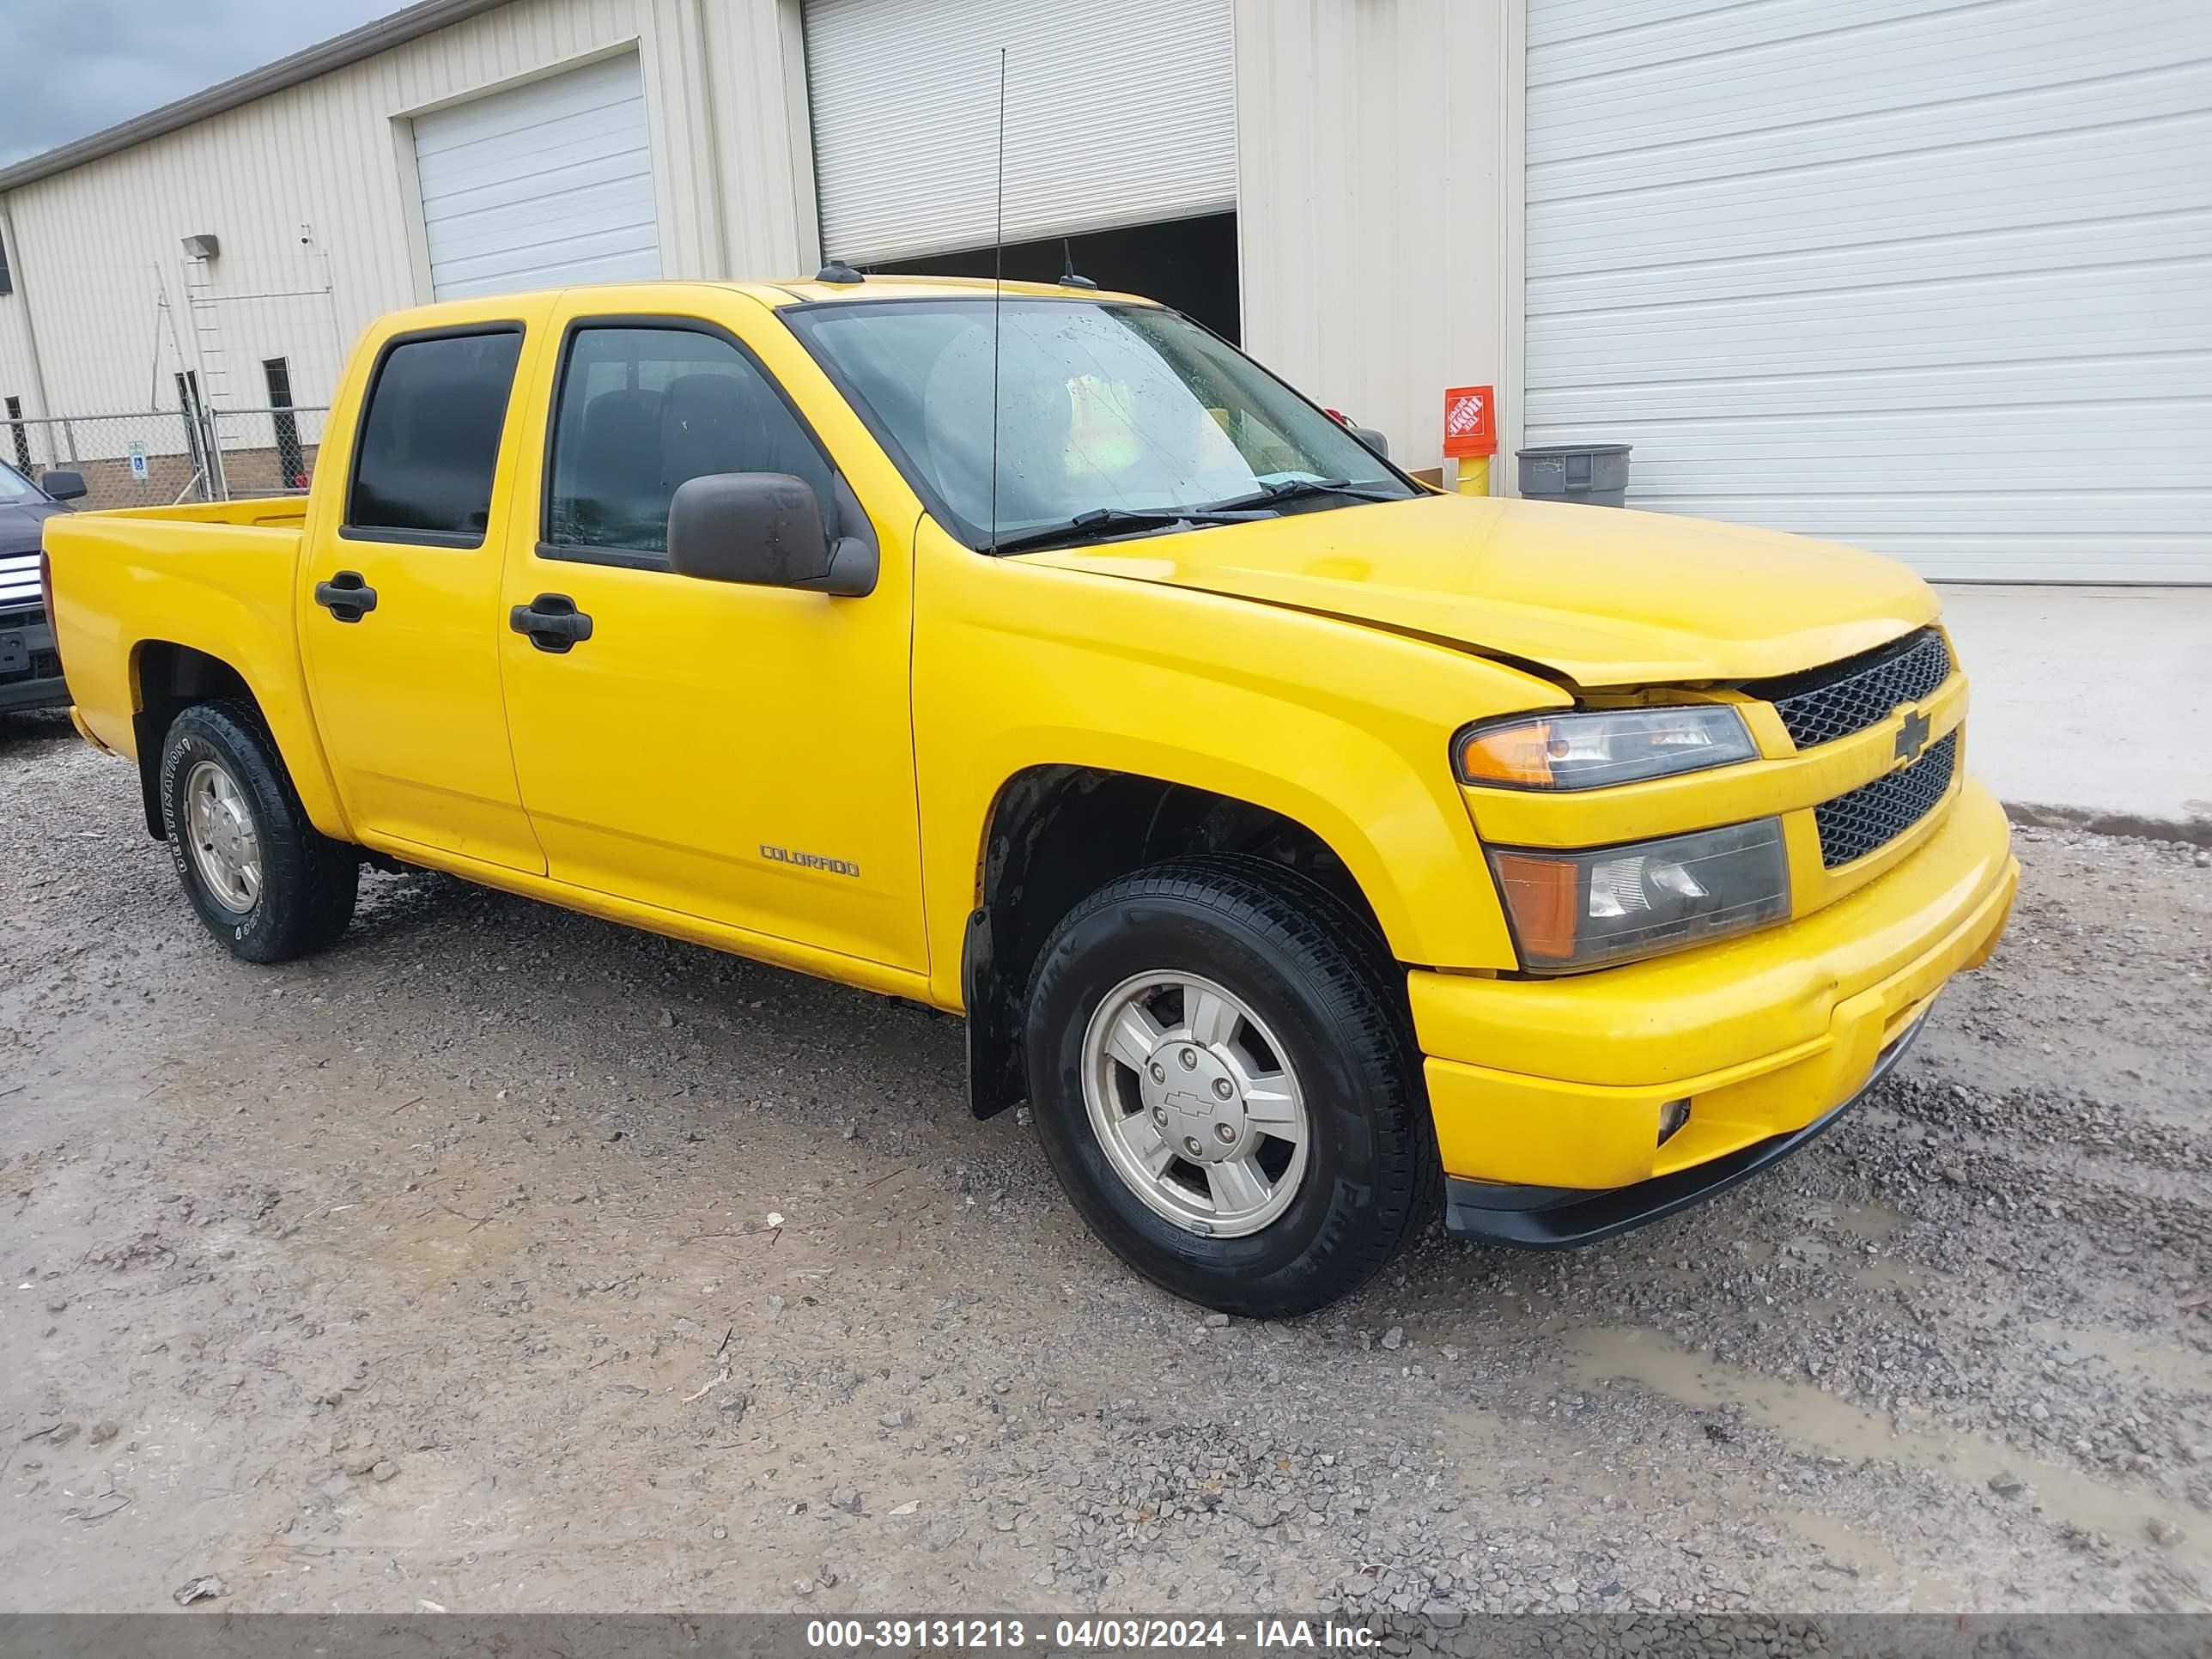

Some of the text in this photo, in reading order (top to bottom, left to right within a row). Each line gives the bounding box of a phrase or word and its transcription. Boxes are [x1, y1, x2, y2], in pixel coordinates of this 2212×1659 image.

[1449, 397, 1482, 435] HOME
[163, 741, 187, 873] DESTINATION
[759, 843, 860, 878] COLORADO
